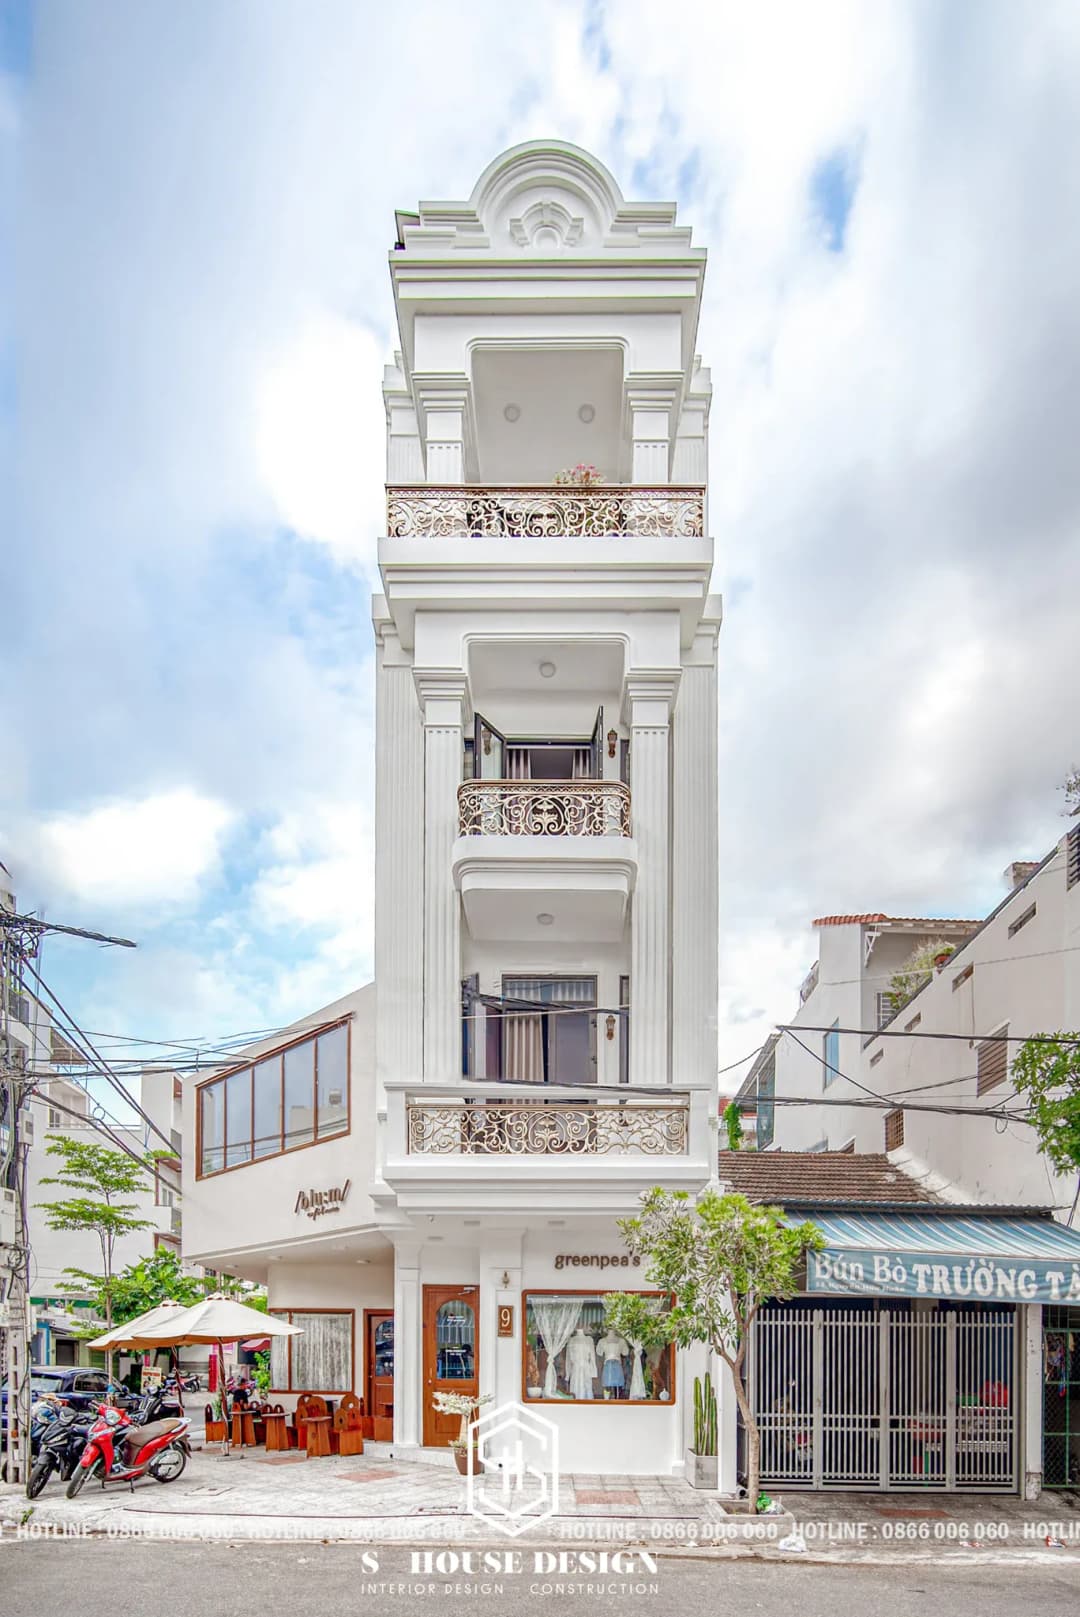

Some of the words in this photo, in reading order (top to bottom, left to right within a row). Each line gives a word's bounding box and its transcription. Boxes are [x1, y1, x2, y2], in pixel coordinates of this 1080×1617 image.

[554, 1250, 641, 1270] greenpea's
[815, 1252, 864, 1281] Bún
[873, 1255, 907, 1284] Bò
[912, 1258, 1039, 1299] TRƯỜNG
[501, 1308, 510, 1328] 9
